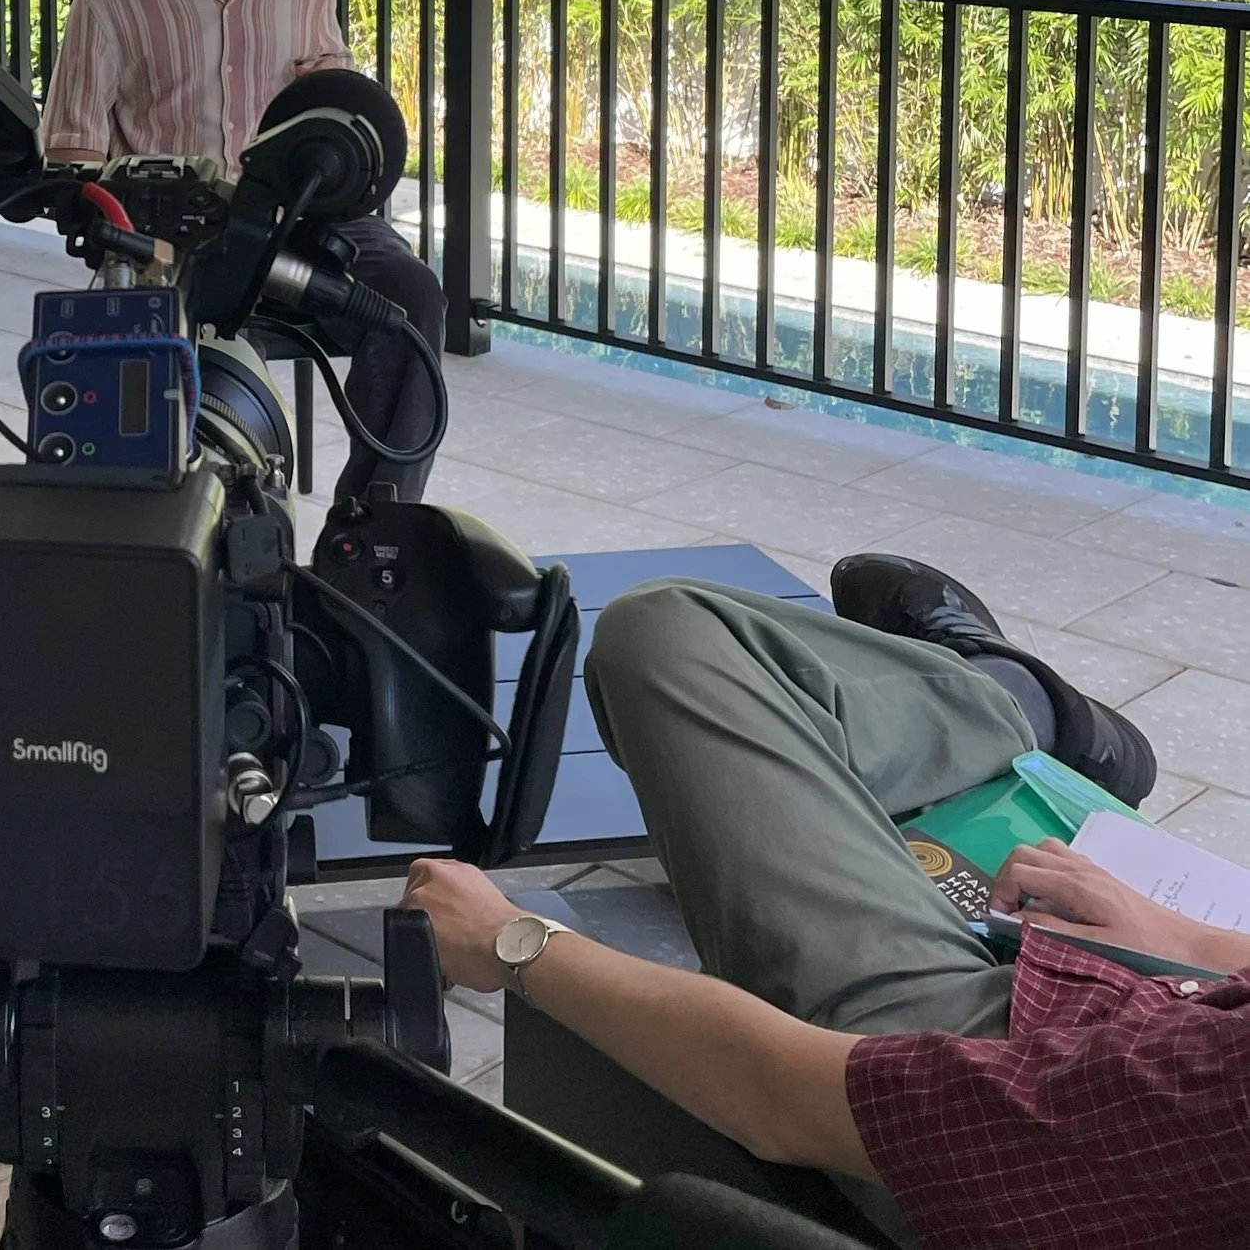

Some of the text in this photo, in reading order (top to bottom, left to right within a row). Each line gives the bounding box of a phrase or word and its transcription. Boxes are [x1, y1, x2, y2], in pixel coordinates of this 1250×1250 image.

[381, 570, 393, 583] 5
[12, 737, 108, 773] SmallRig
[937, 882, 983, 920] FILMS
[232, 1080, 240, 1094] 1
[41, 1106, 52, 1118] 3
[232, 1106, 242, 1118] 2
[232, 1128, 242, 1139] 3
[43, 1137, 53, 1147] 2
[232, 1147, 243, 1157] 4
